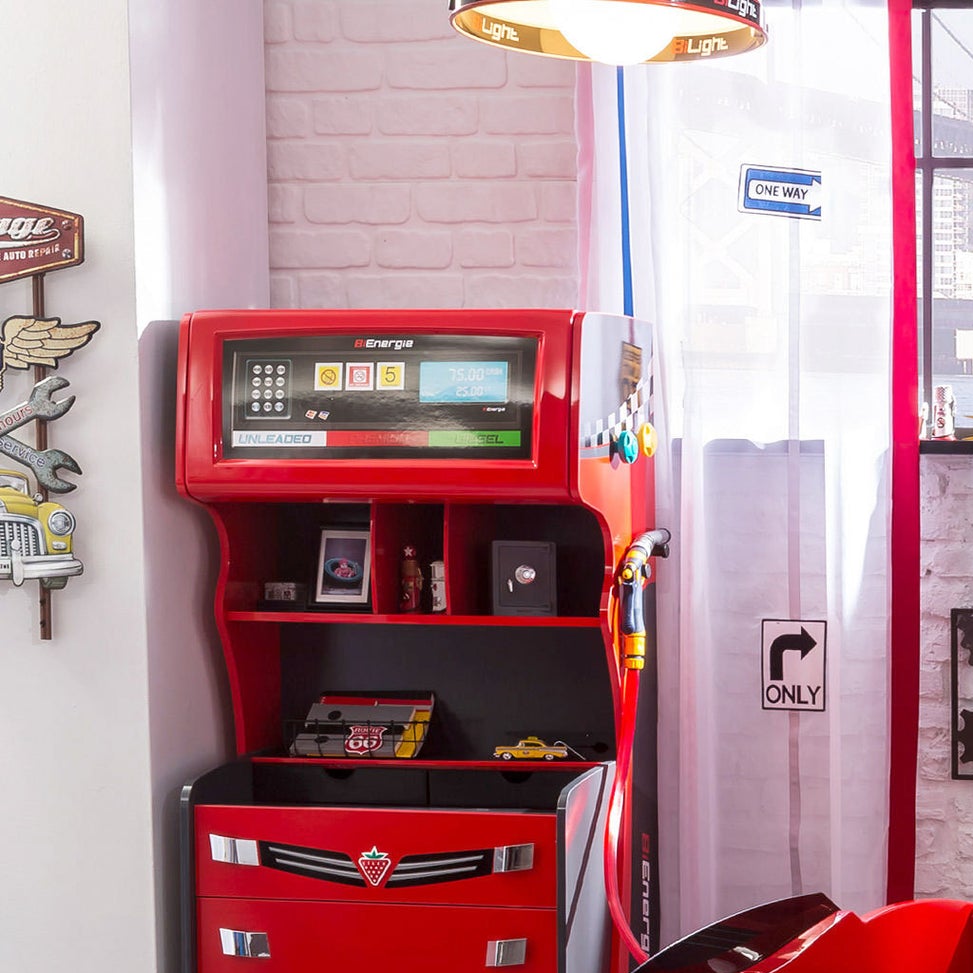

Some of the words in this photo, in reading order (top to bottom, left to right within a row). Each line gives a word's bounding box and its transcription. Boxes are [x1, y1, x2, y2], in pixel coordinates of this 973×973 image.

[755, 183, 779, 197] ONE
[782, 185, 809, 201] WAY
[3, 250, 26, 261] AUTO
[28, 243, 60, 259] REPAIR
[385, 366, 397, 383] 5
[765, 684, 822, 705] ONLY
[641, 832, 651, 954] BiEnerg
